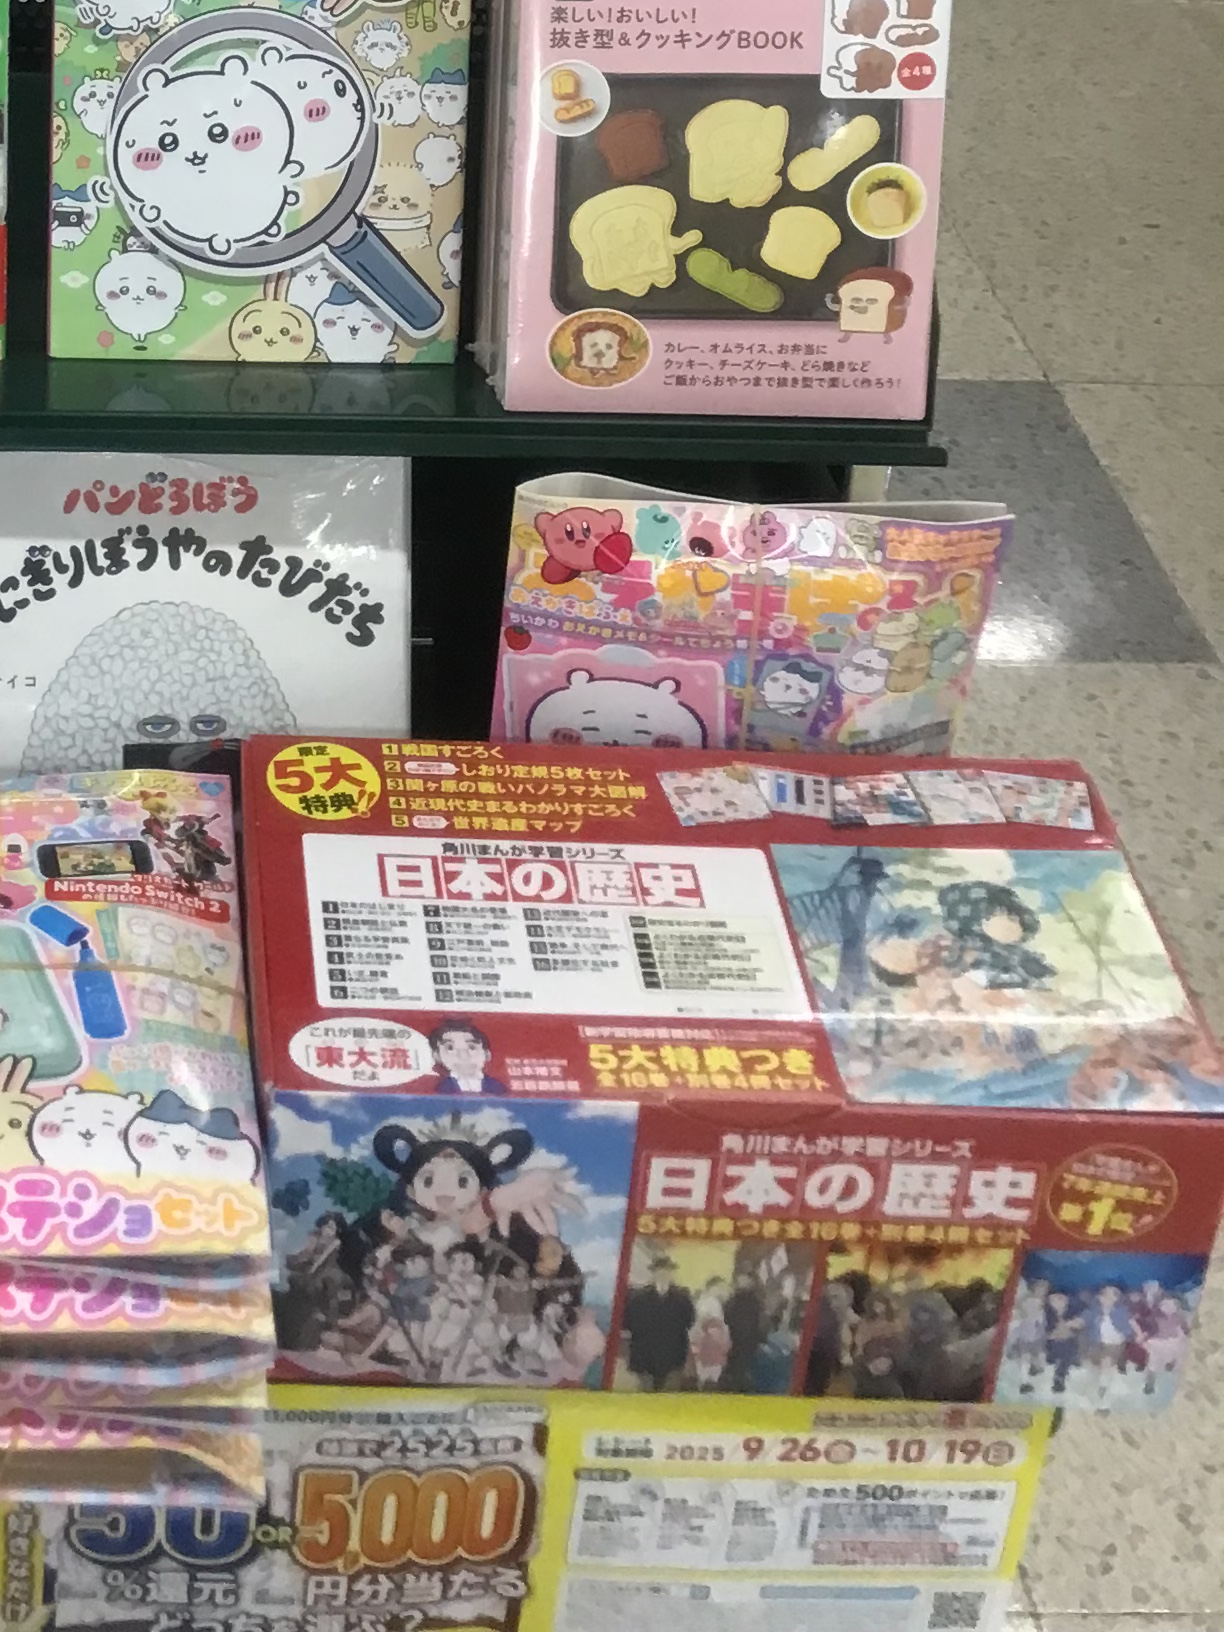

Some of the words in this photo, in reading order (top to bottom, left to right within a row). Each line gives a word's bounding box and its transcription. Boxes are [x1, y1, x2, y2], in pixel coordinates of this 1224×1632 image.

[549, 5, 698, 25] 楽しい!おいしい!
[548, 27, 805, 52] 抜き型&クッキングBOOK
[663, 341, 828, 357] カレー、オムライス、お弁当に
[62, 474, 259, 517] パンどろぼう
[297, 745, 330, 758] 限定
[272, 756, 369, 796] 5大
[441, 841, 627, 861] 角川まんが学習シリーズ
[52, 878, 143, 897] Nintendo
[145, 884, 205, 910] Switch
[208, 899, 222, 914] 2
[380, 854, 705, 908] 日本の歴史
[587, 1043, 816, 1076] 5大特典つき
[721, 1132, 973, 1159] 角川まんが学習シリーズ
[643, 1156, 1039, 1222] 日本の歴史
[294, 1465, 528, 1573] 5,000
[305, 1568, 528, 1607] 円分当たる
